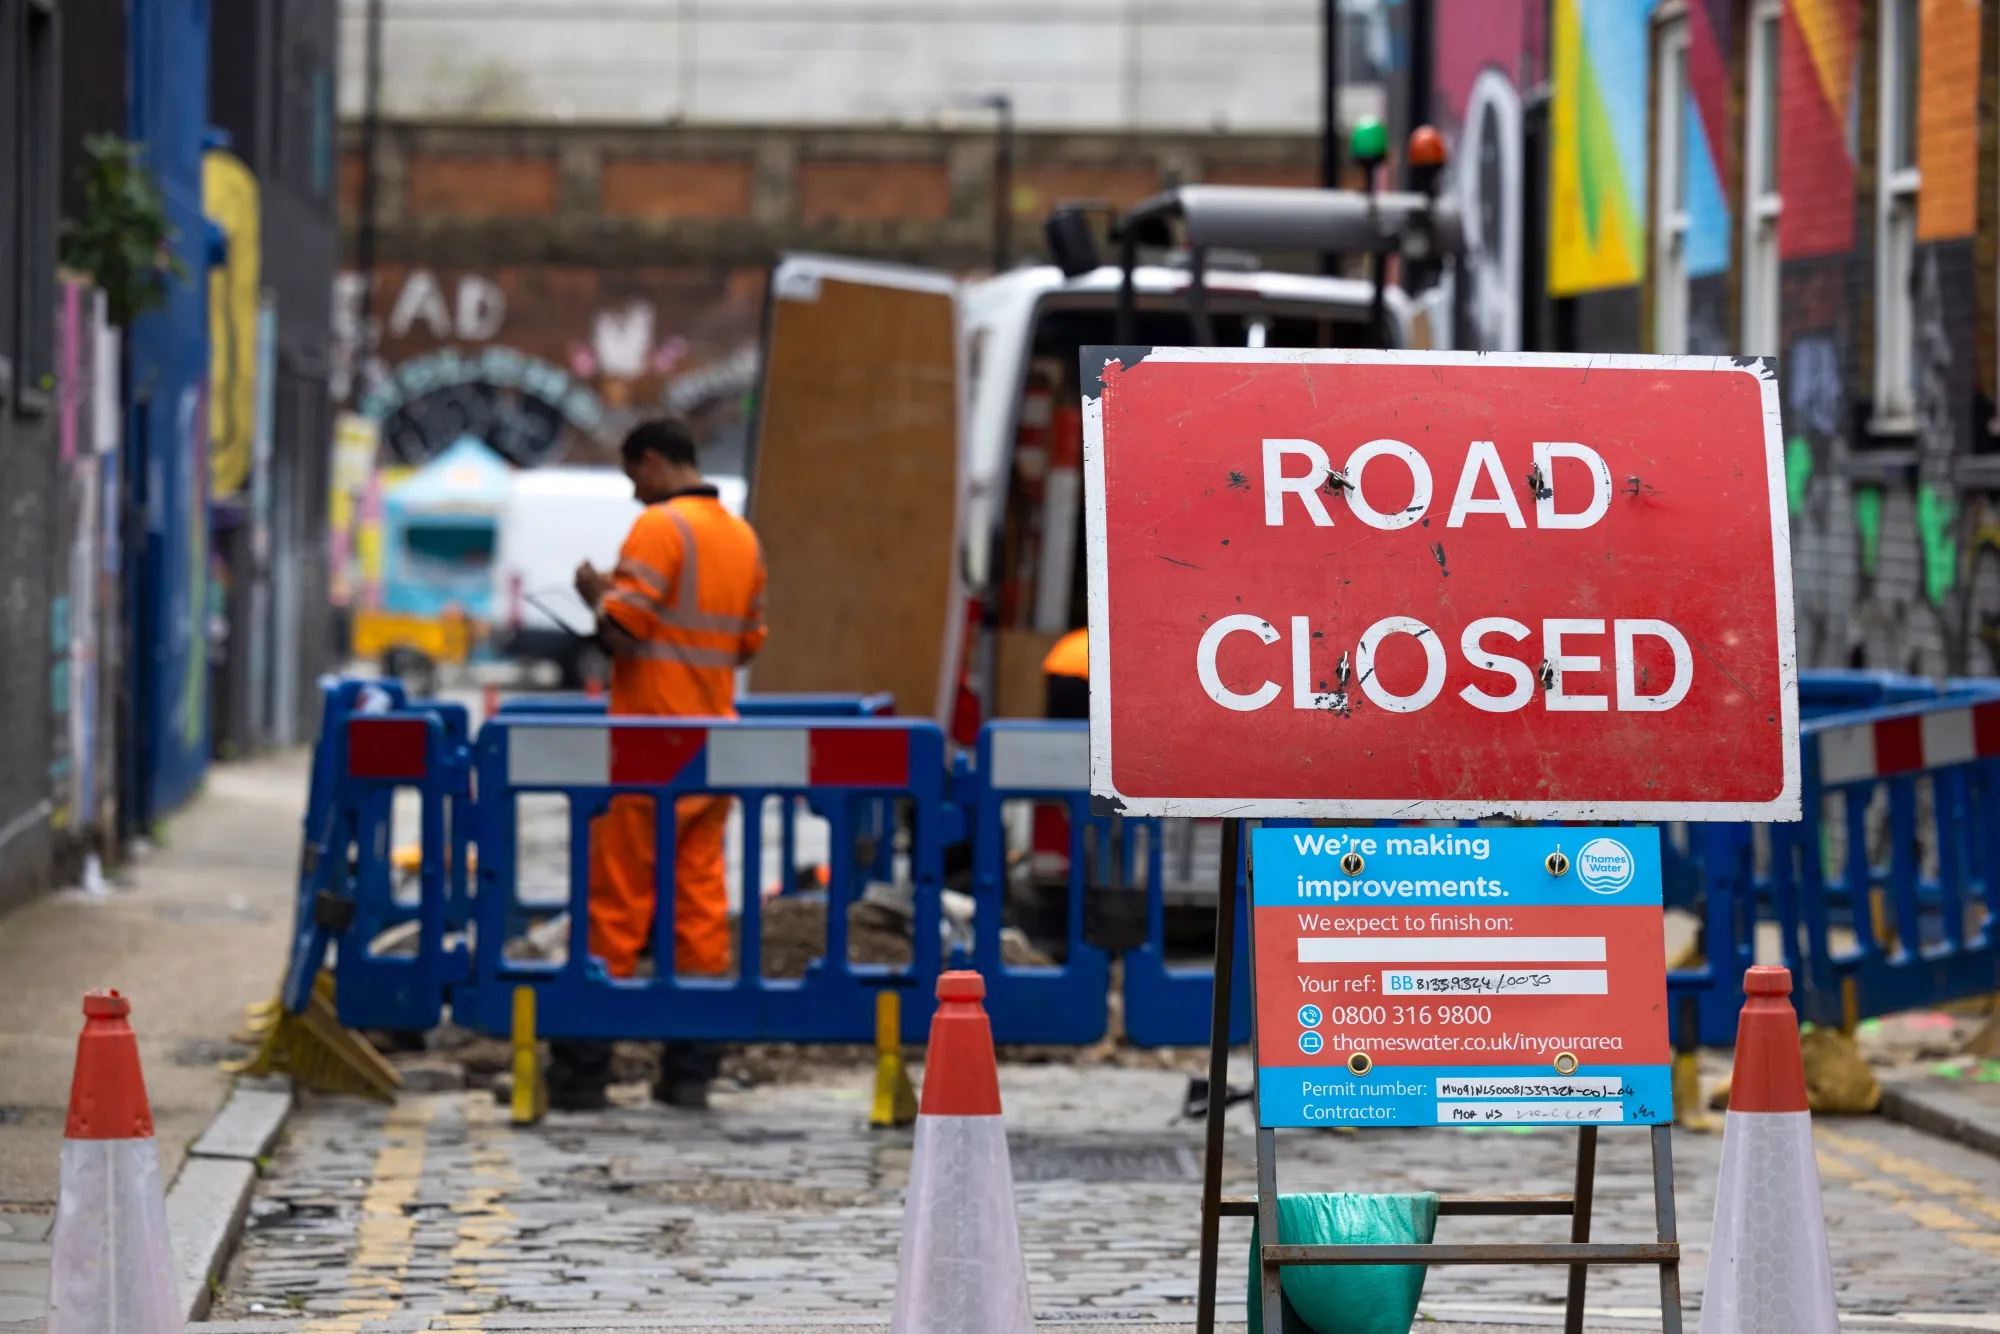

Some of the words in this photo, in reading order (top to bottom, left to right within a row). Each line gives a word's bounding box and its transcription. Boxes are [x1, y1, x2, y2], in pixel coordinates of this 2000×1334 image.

[1262, 438, 1612, 531] ROAD
[1197, 614, 1694, 713] CLOSED
[1386, 833, 1490, 860] making
[1584, 854, 1626, 864] Thames
[1589, 863, 1622, 872] Water
[1297, 875, 1509, 902] improvements.
[1298, 914, 1333, 930] We
[1334, 915, 1399, 935] expect
[1404, 916, 1425, 930] to
[1430, 914, 1480, 930] finish
[1484, 917, 1514, 930] on:
[1297, 976, 1340, 992] Your
[1344, 974, 1376, 992] ref:
[1332, 1006, 1386, 1025] 0800
[1392, 1006, 1431, 1024] 316
[1438, 1006, 1491, 1025] 9800
[1333, 1033, 1623, 1055] thameswater.co.uk/inyourarea
[1302, 1081, 1356, 1096] Permit
[1359, 1082, 1427, 1096] number:
[1303, 1105, 1396, 1119] Contractor:
